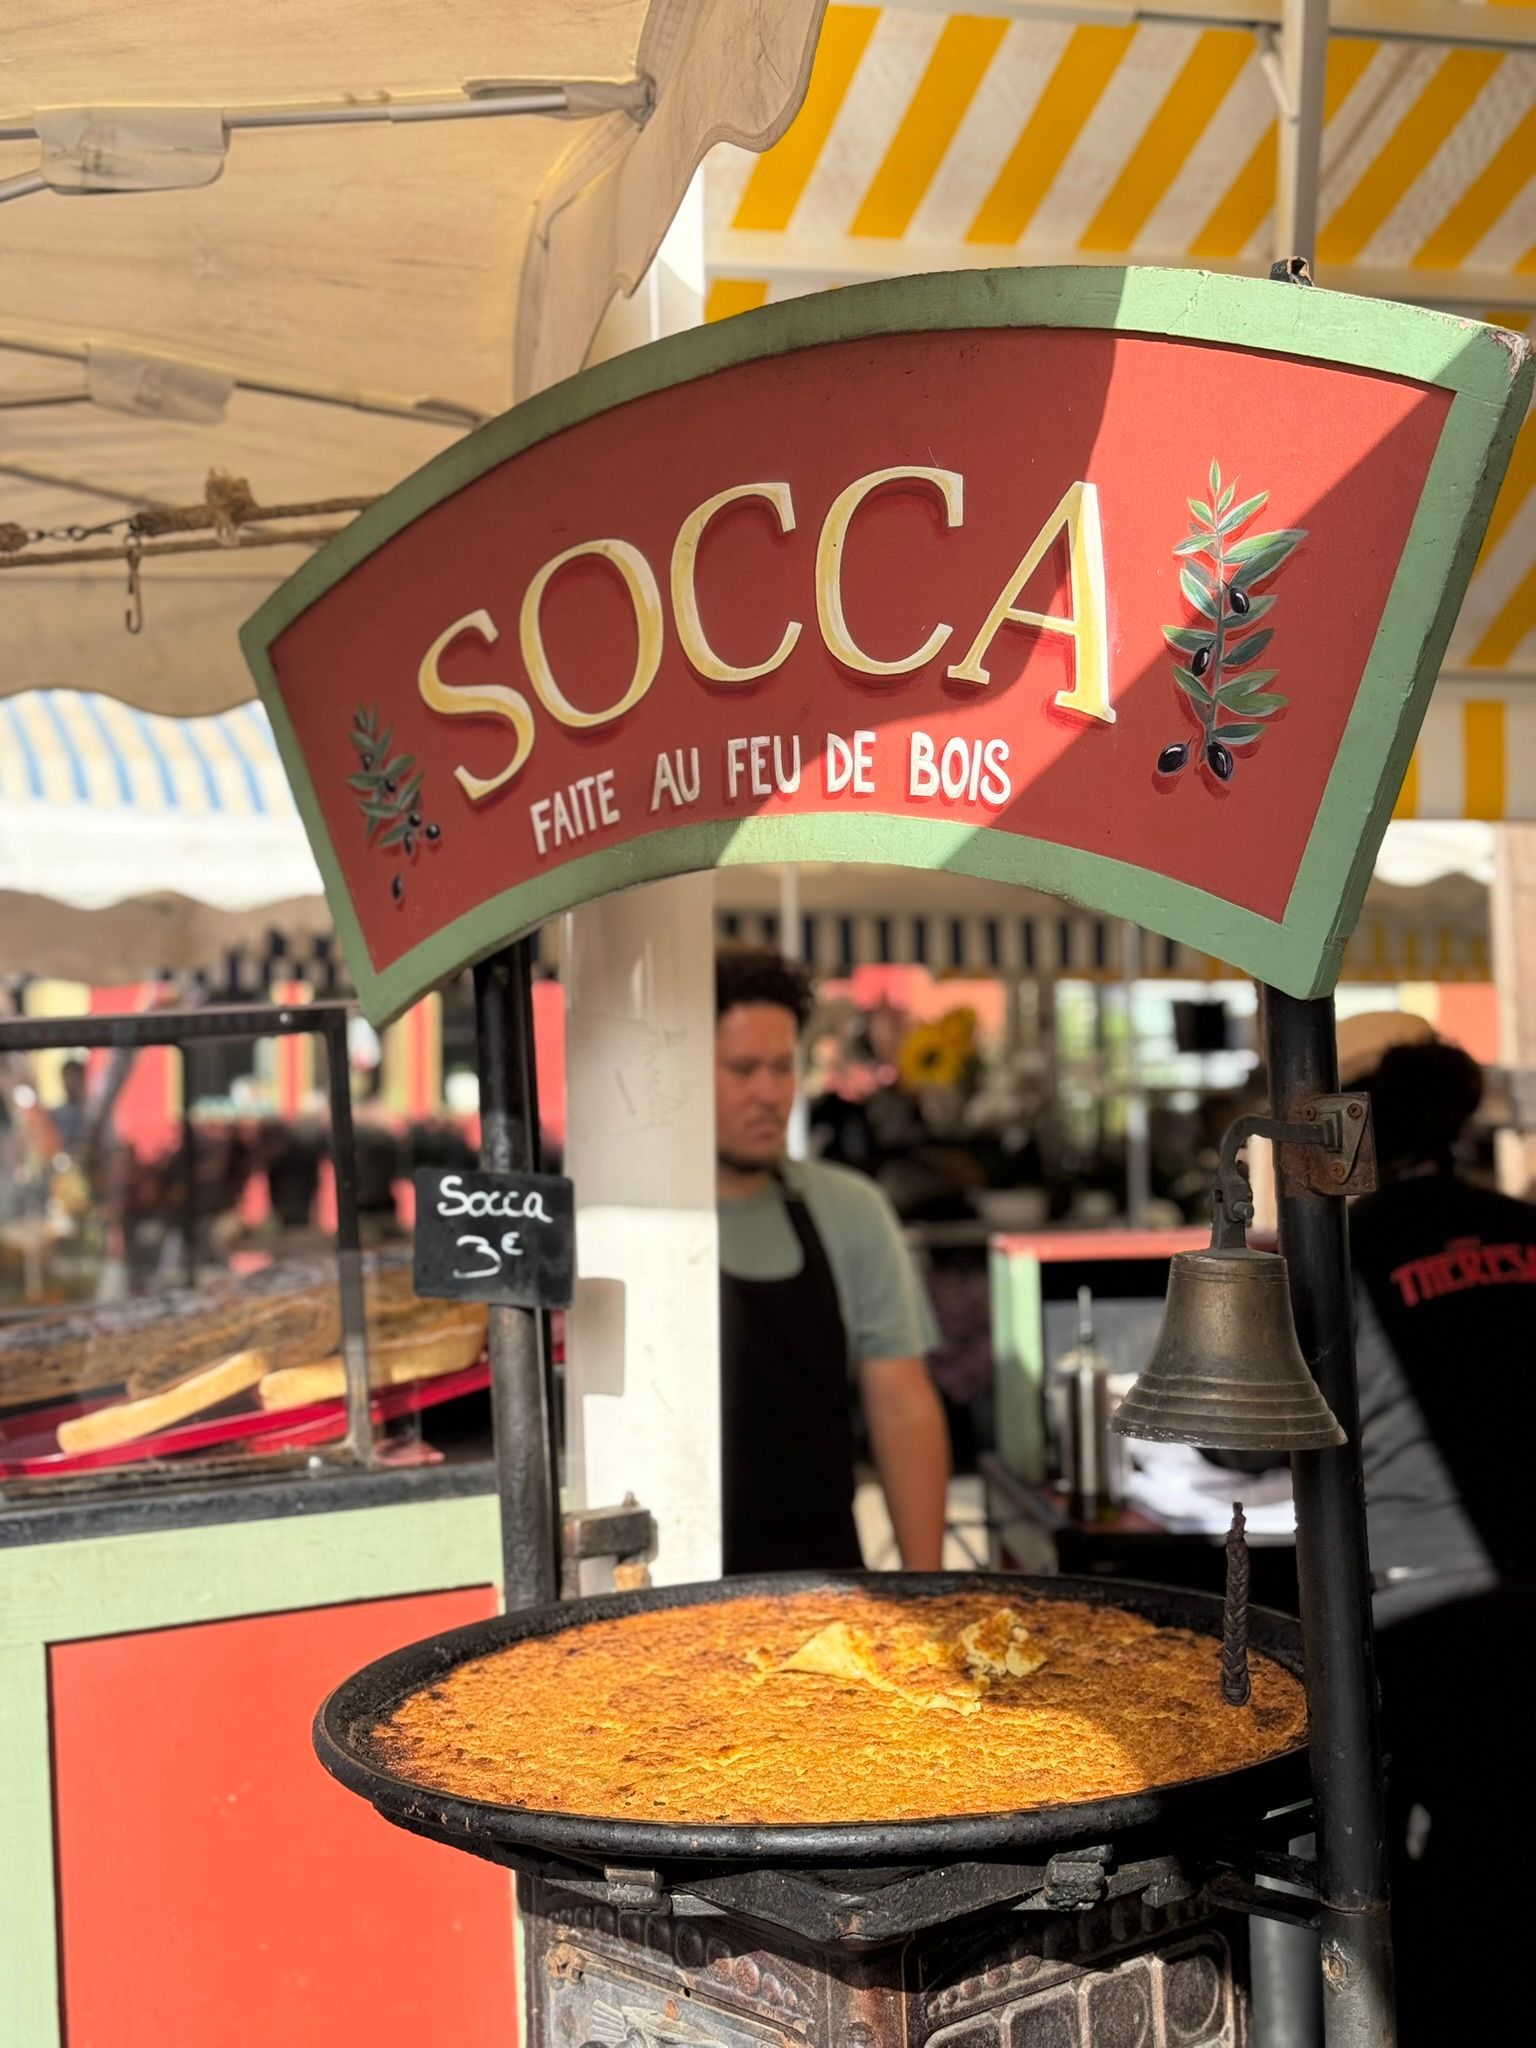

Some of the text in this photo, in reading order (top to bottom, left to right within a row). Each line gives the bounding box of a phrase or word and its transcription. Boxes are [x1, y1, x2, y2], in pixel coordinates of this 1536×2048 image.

[418, 466, 1117, 799] SOCCA
[530, 730, 1012, 853] FAITE AU FEU DE BOIS
[437, 1175, 553, 1223] Socca
